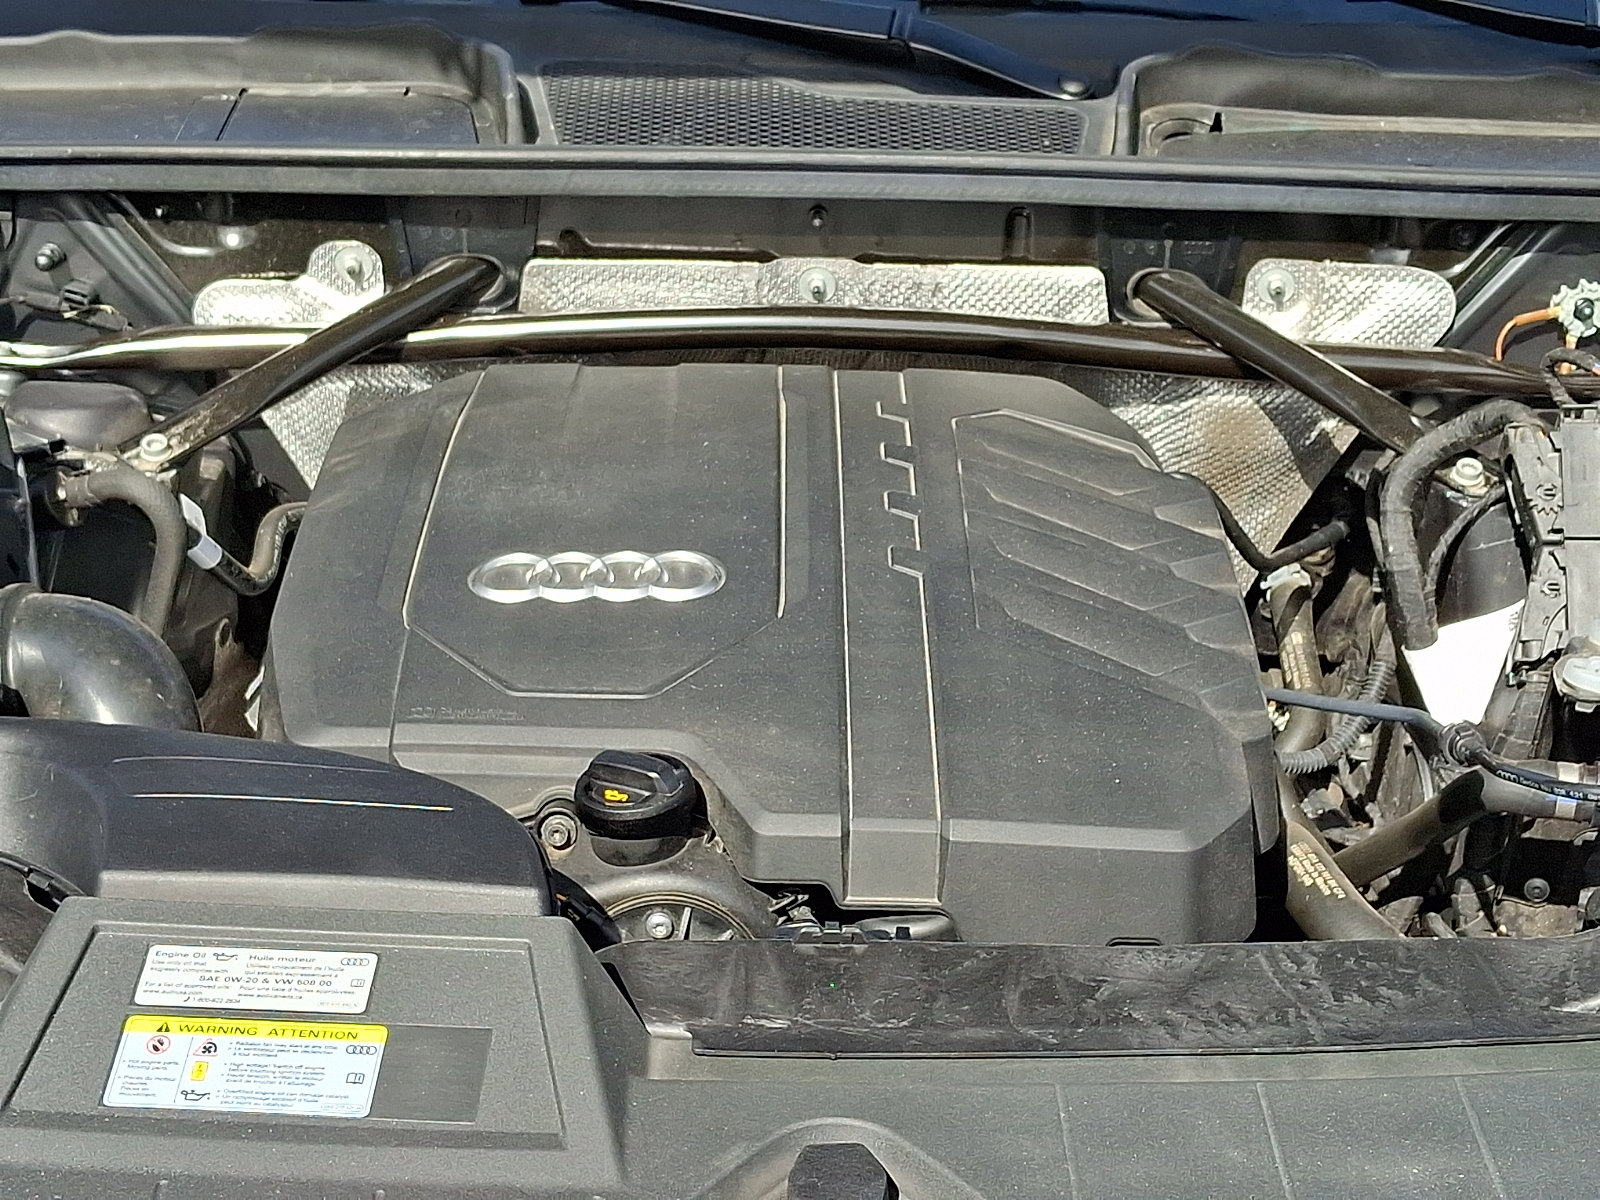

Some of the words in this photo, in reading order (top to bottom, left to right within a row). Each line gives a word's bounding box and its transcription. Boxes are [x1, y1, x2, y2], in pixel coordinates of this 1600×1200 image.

[155, 950, 189, 959] Engine
[224, 976, 258, 984] 0W-20
[319, 979, 332, 987] 00
[179, 1024, 258, 1036] WARNING
[267, 1028, 359, 1040] ATTENTION
